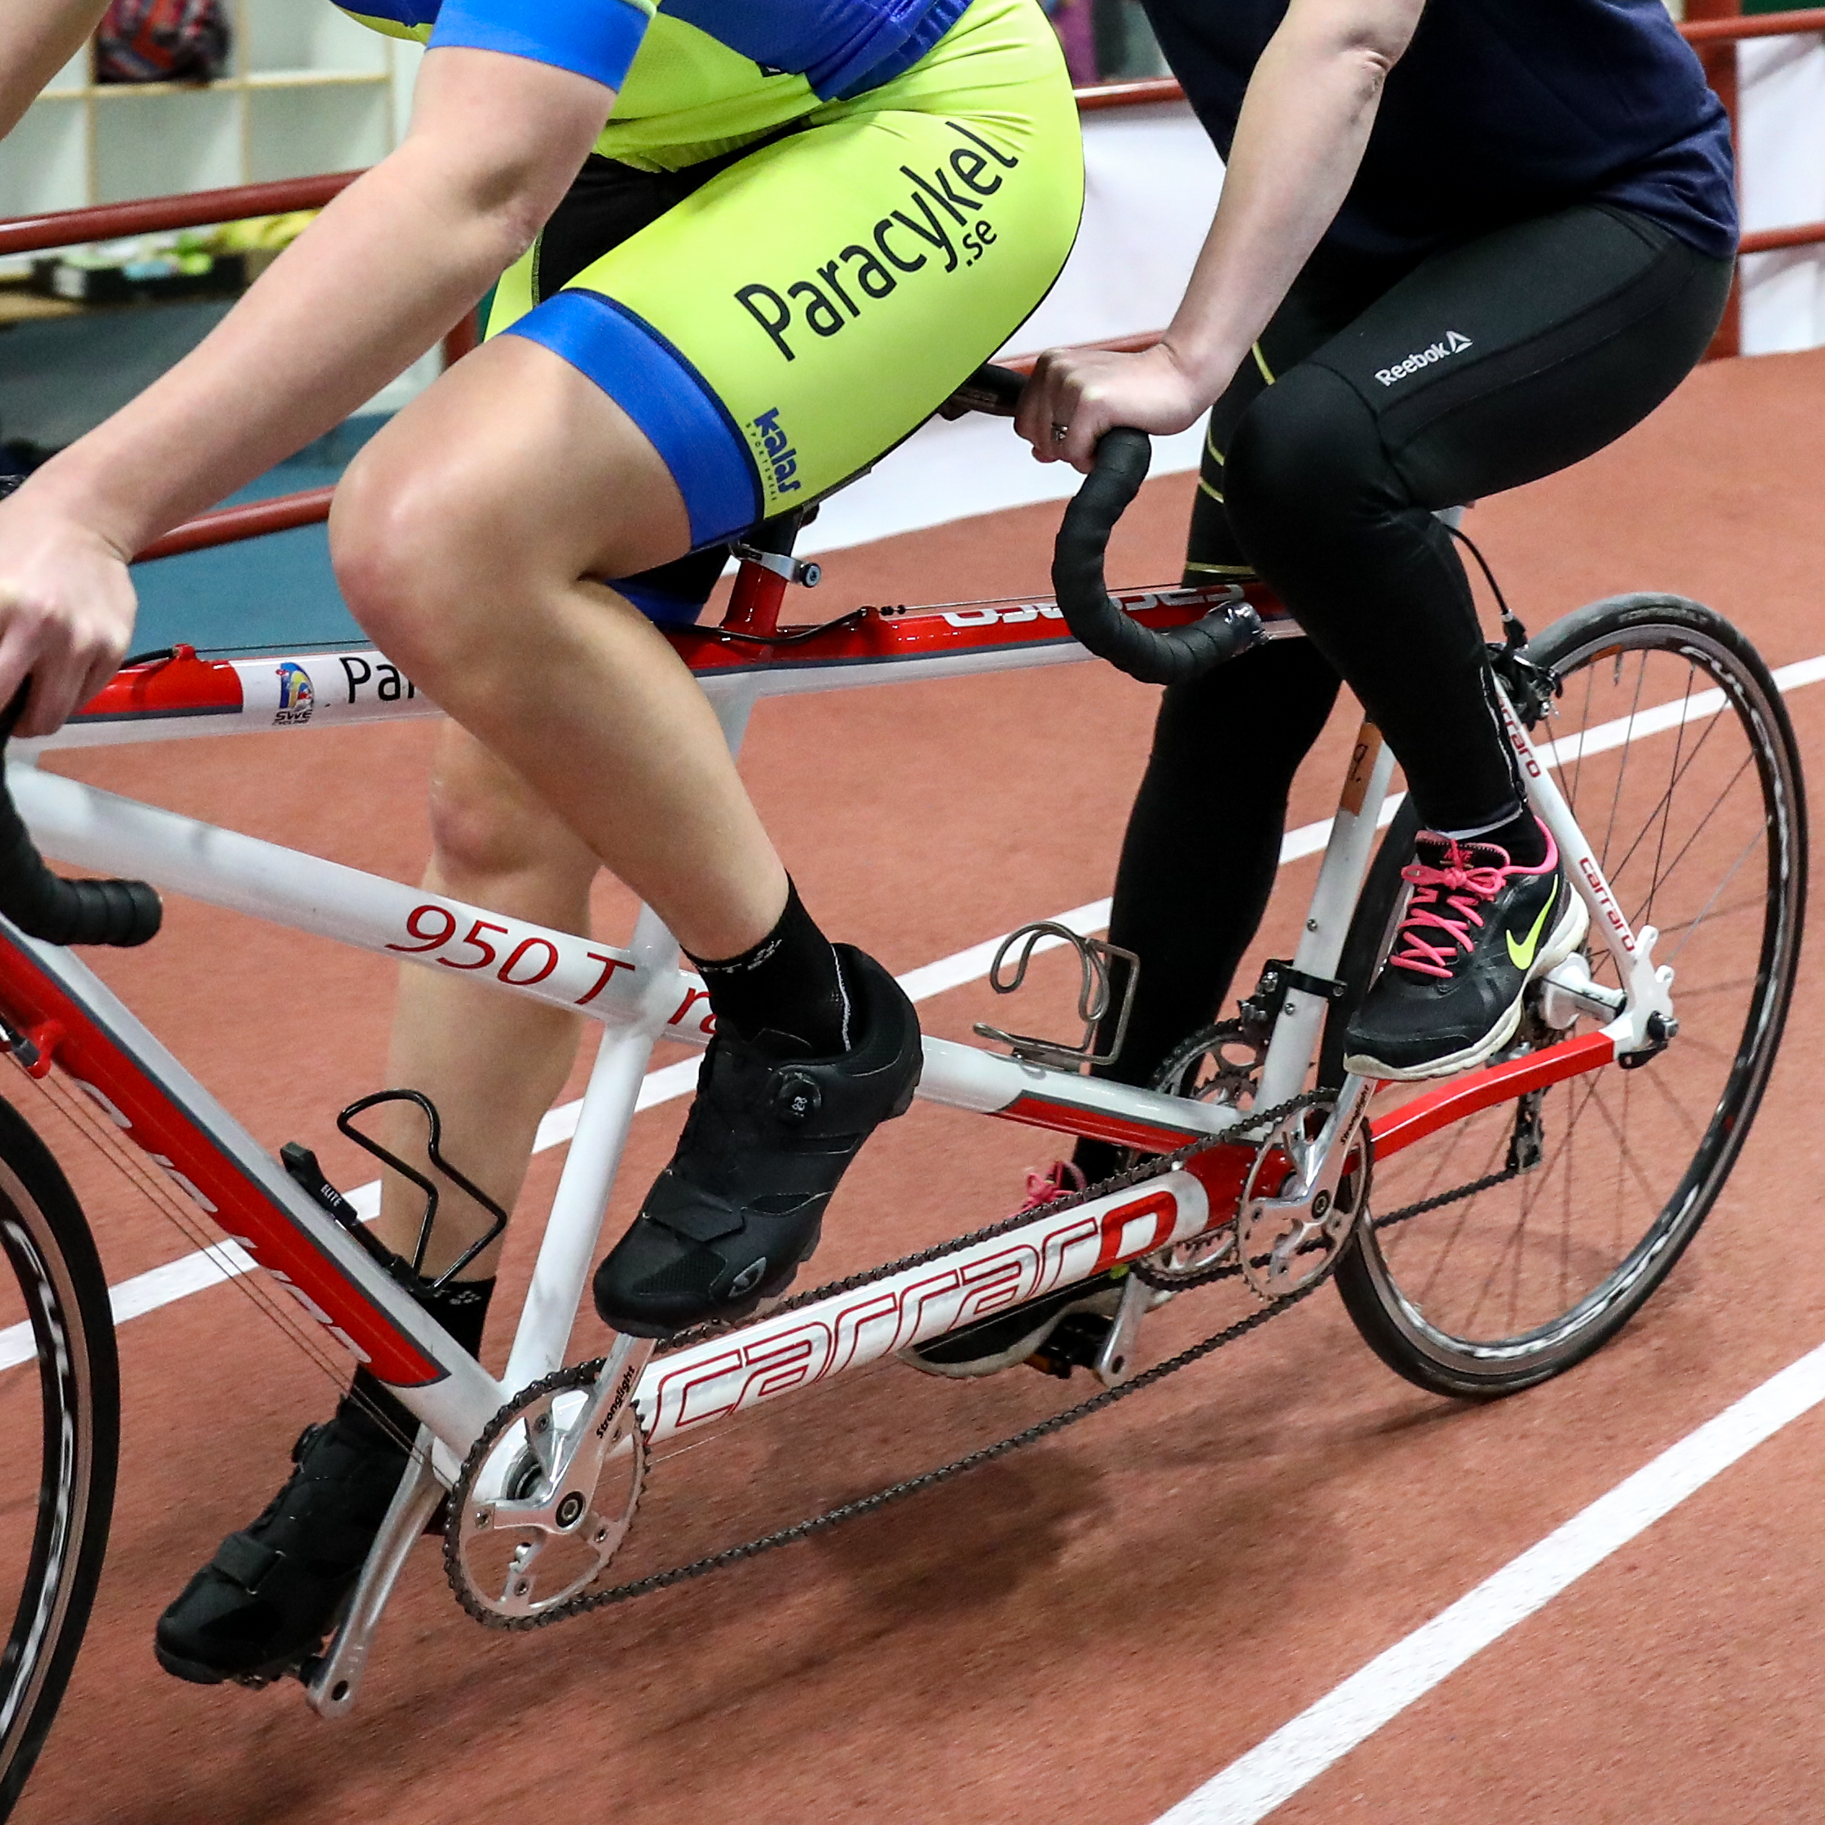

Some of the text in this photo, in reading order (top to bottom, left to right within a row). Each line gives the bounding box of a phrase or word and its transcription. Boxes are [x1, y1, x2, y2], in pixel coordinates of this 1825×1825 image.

[733, 120, 1019, 362] Paracykel
[961, 219, 998, 267] .se
[1374, 340, 1451, 387] Reebok
[753, 407, 802, 493] kalas
[384, 904, 559, 986] 950
[1579, 856, 1636, 952] carraro
[319, 1183, 342, 1208] ELITE
[644, 1190, 1179, 1446] carraro
[596, 1365, 636, 1439] Stronglight
